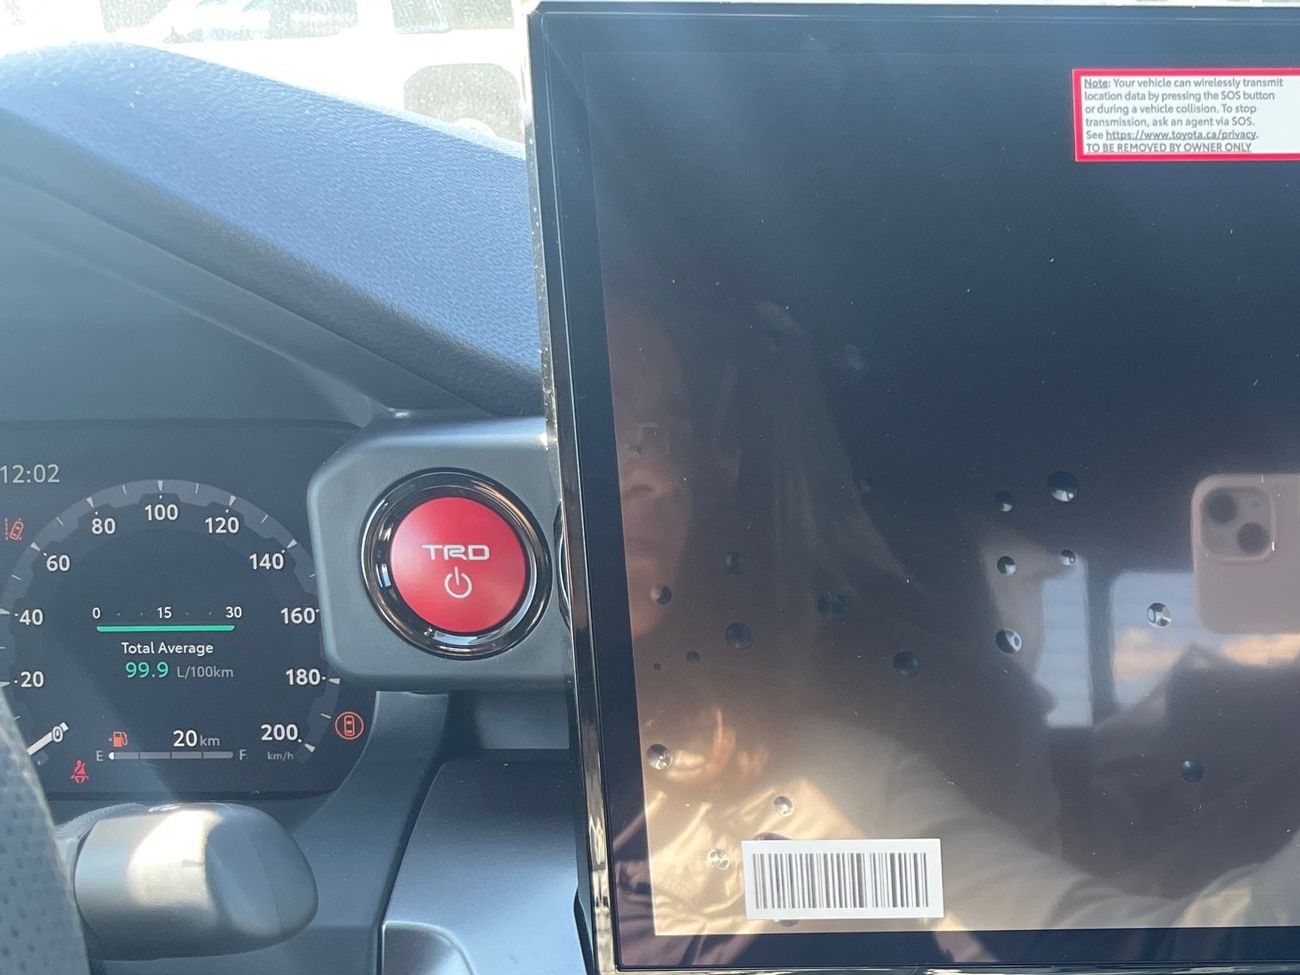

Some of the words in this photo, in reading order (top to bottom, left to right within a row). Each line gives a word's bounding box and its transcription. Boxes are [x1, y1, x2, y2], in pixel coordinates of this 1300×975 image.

[1084, 78, 1111, 88] Note:
[1113, 78, 1135, 88] Your
[1137, 78, 1172, 88] vehicle
[1173, 80, 1191, 88] can
[1194, 77, 1240, 89] wirelessly
[1243, 77, 1284, 87] transmit
[1084, 90, 1122, 100] location
[1124, 90, 1146, 100] data
[1148, 90, 1159, 102] by
[1161, 90, 1202, 102] pressing
[1204, 90, 1218, 100] the
[1220, 90, 1241, 100] SOS
[1242, 90, 1275, 100] button
[1085, 106, 1095, 114] or
[1097, 104, 1129, 116] during
[1132, 106, 1137, 114] a
[1140, 104, 1174, 114] vehicle
[1176, 104, 1220, 114] collision.
[1221, 104, 1232, 113] To
[1235, 104, 1256, 115] stop
[1086, 117, 1150, 127] transmission,
[1152, 117, 1168, 126] ask
[1186, 118, 1214, 128] agent
[1216, 116, 1230, 126] via
[1232, 116, 1254, 126] SOS.
[1086, 130, 1104, 140] See
[1106, 130, 1259, 141] https://www.toyota.ca/privacy.
[1086, 143, 1100, 152] TO
[1102, 143, 1114, 152] BE
[1117, 143, 1166, 152] REMOVED
[1169, 143, 1181, 152] BY
[1184, 142, 1222, 152] OWNER
[1224, 142, 1252, 152] ONLY
[0, 464, 60, 483] 12:02
[144, 503, 179, 521] 100
[92, 518, 116, 535] 80
[205, 517, 240, 534] 120
[421, 544, 490, 560] TRD
[46, 554, 71, 572] 60
[250, 552, 285, 570] 140
[19, 608, 44, 627] 40
[92, 607, 101, 619] 0
[156, 607, 172, 619] 15
[225, 607, 242, 619] 30
[280, 607, 316, 625] 160
[121, 642, 155, 655] Total
[158, 642, 214, 657] Average
[124, 661, 169, 678] 99.9
[176, 665, 234, 678] L/100km
[284, 668, 321, 686] 180
[20, 670, 45, 688] 20
[51, 725, 64, 743] 0
[172, 729, 198, 747] 20
[200, 734, 220, 746] km
[260, 723, 299, 742] 200
[96, 750, 104, 762] E
[239, 748, 247, 761] F
[266, 751, 294, 762] km/h
